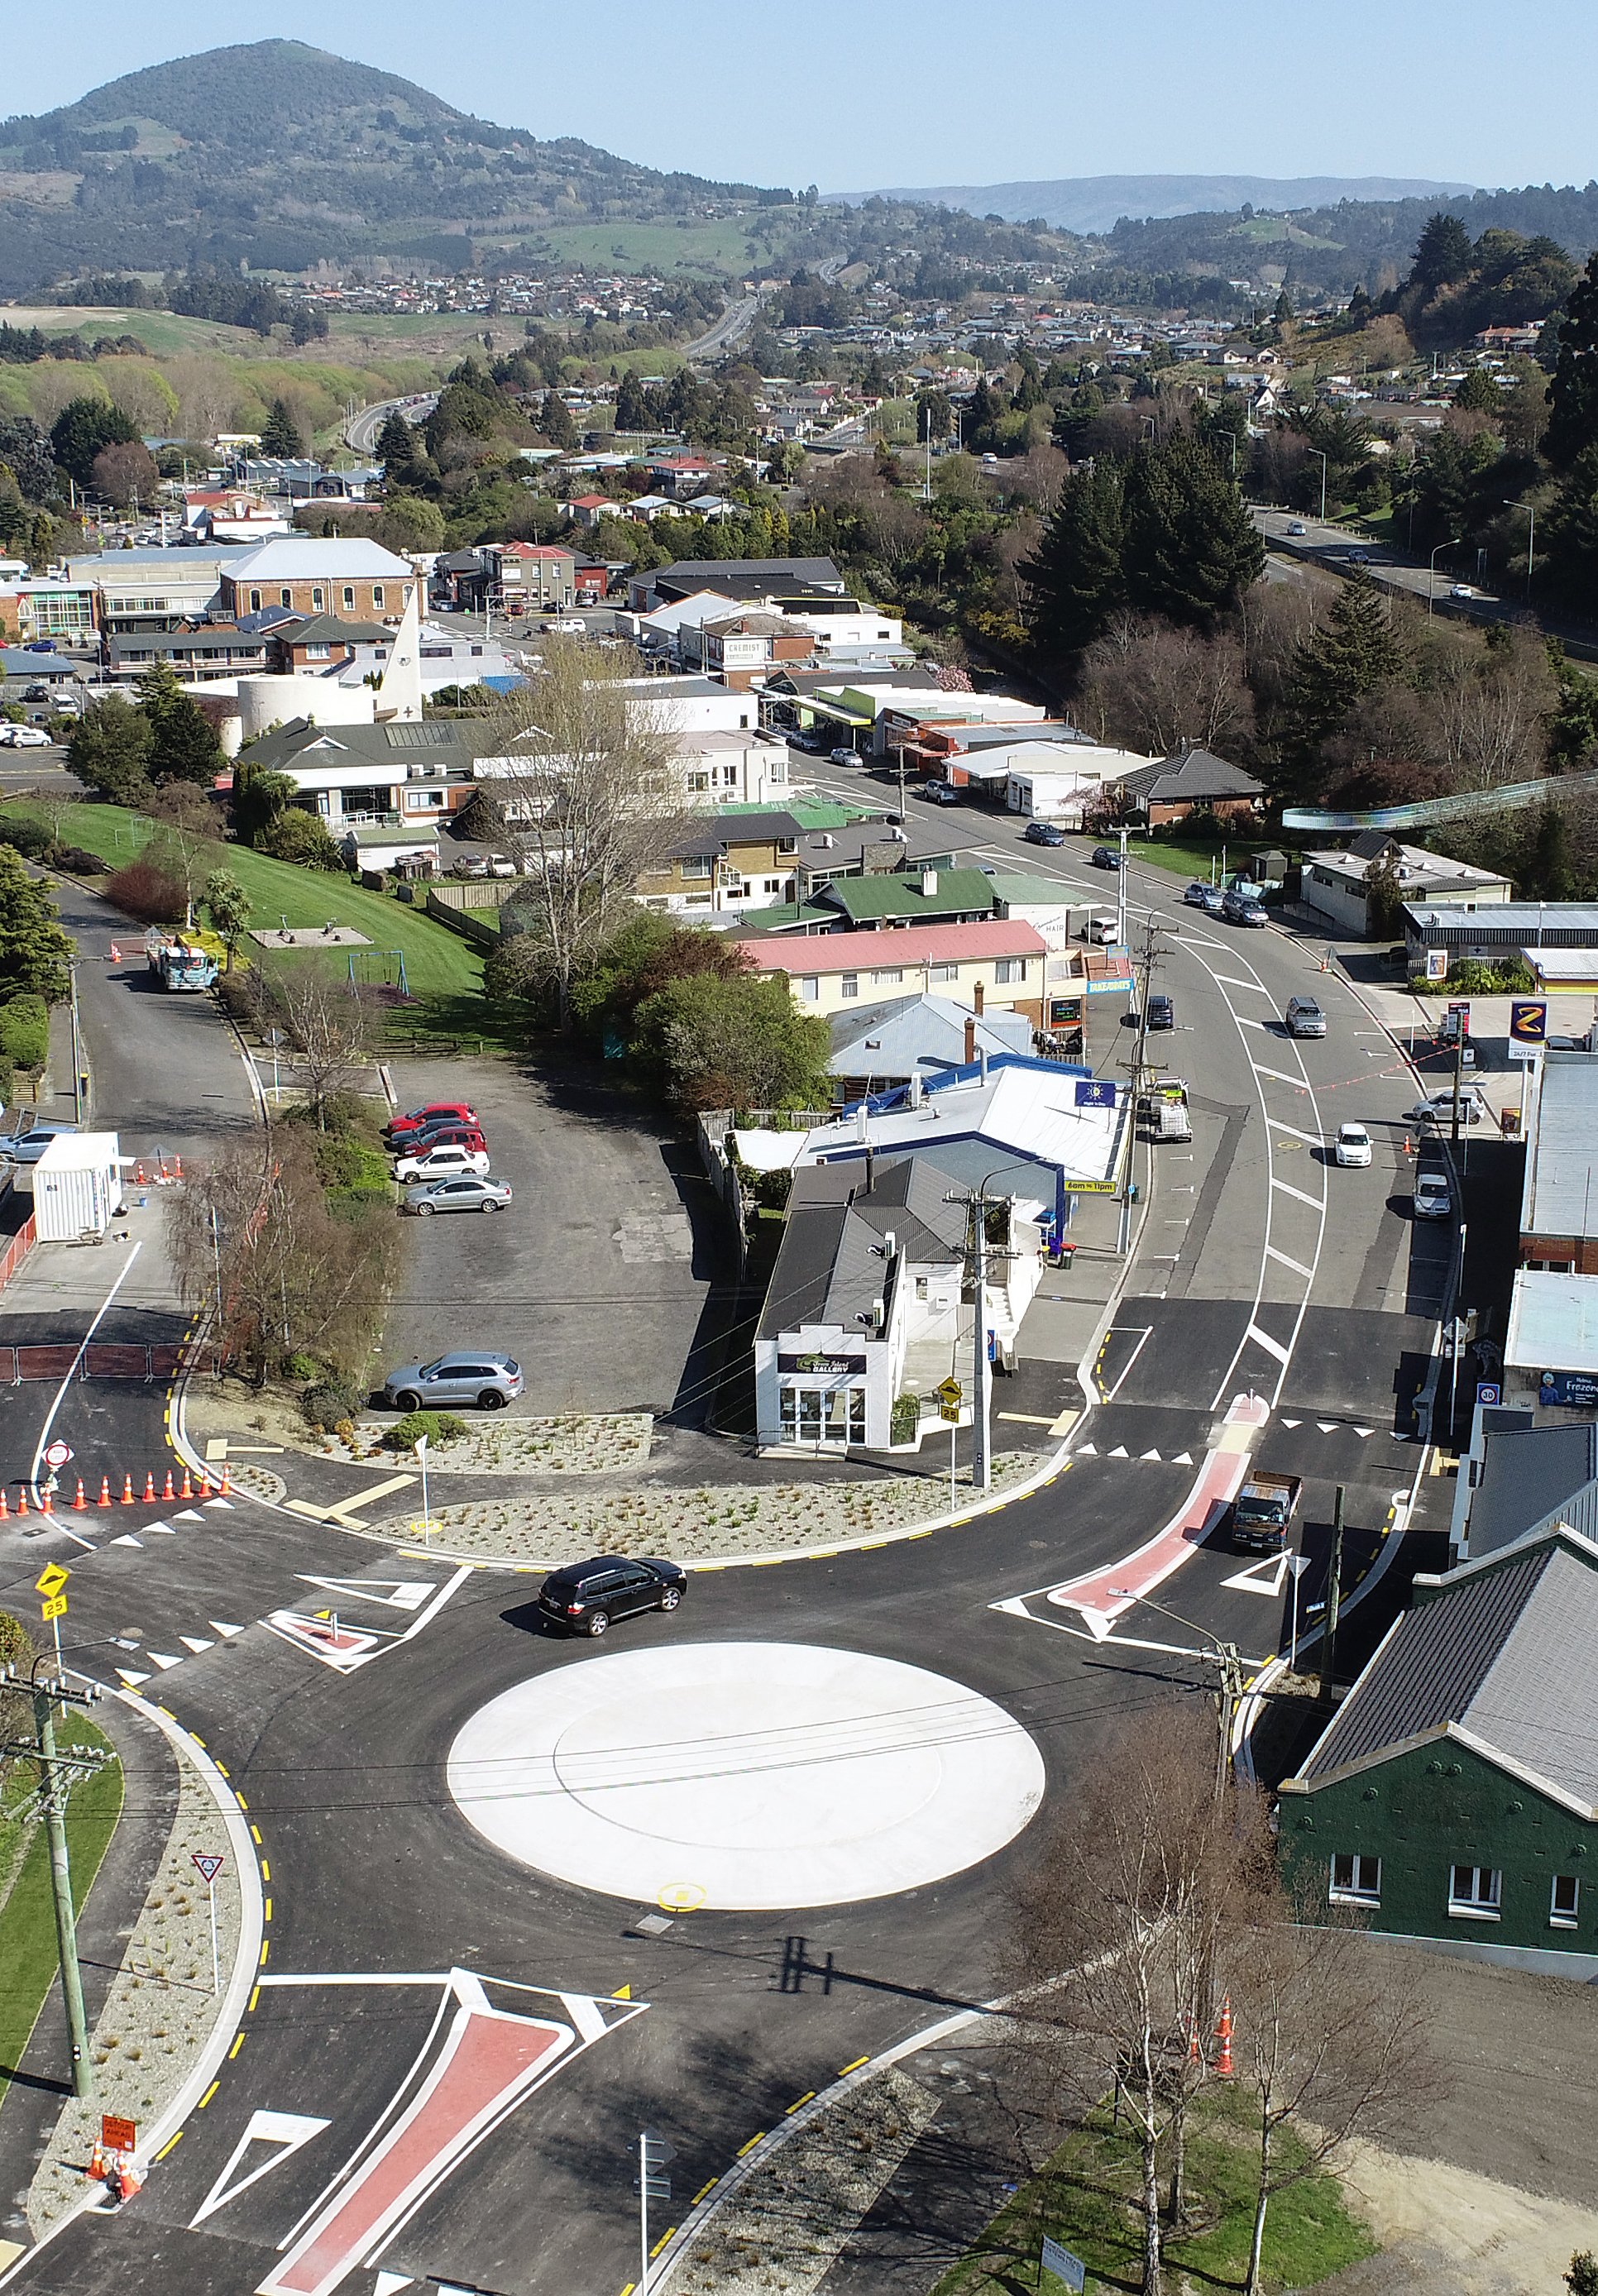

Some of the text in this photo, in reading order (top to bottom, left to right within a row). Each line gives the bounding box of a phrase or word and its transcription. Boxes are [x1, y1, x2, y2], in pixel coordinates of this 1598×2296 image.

[1045, 924, 1065, 932] HAIR
[1515, 1007, 1543, 1033] Z
[1093, 1182, 1112, 1191] 11pm
[1483, 1390, 1494, 1399] 30
[943, 1409, 957, 1420] 25
[46, 1600, 63, 1615] 25
